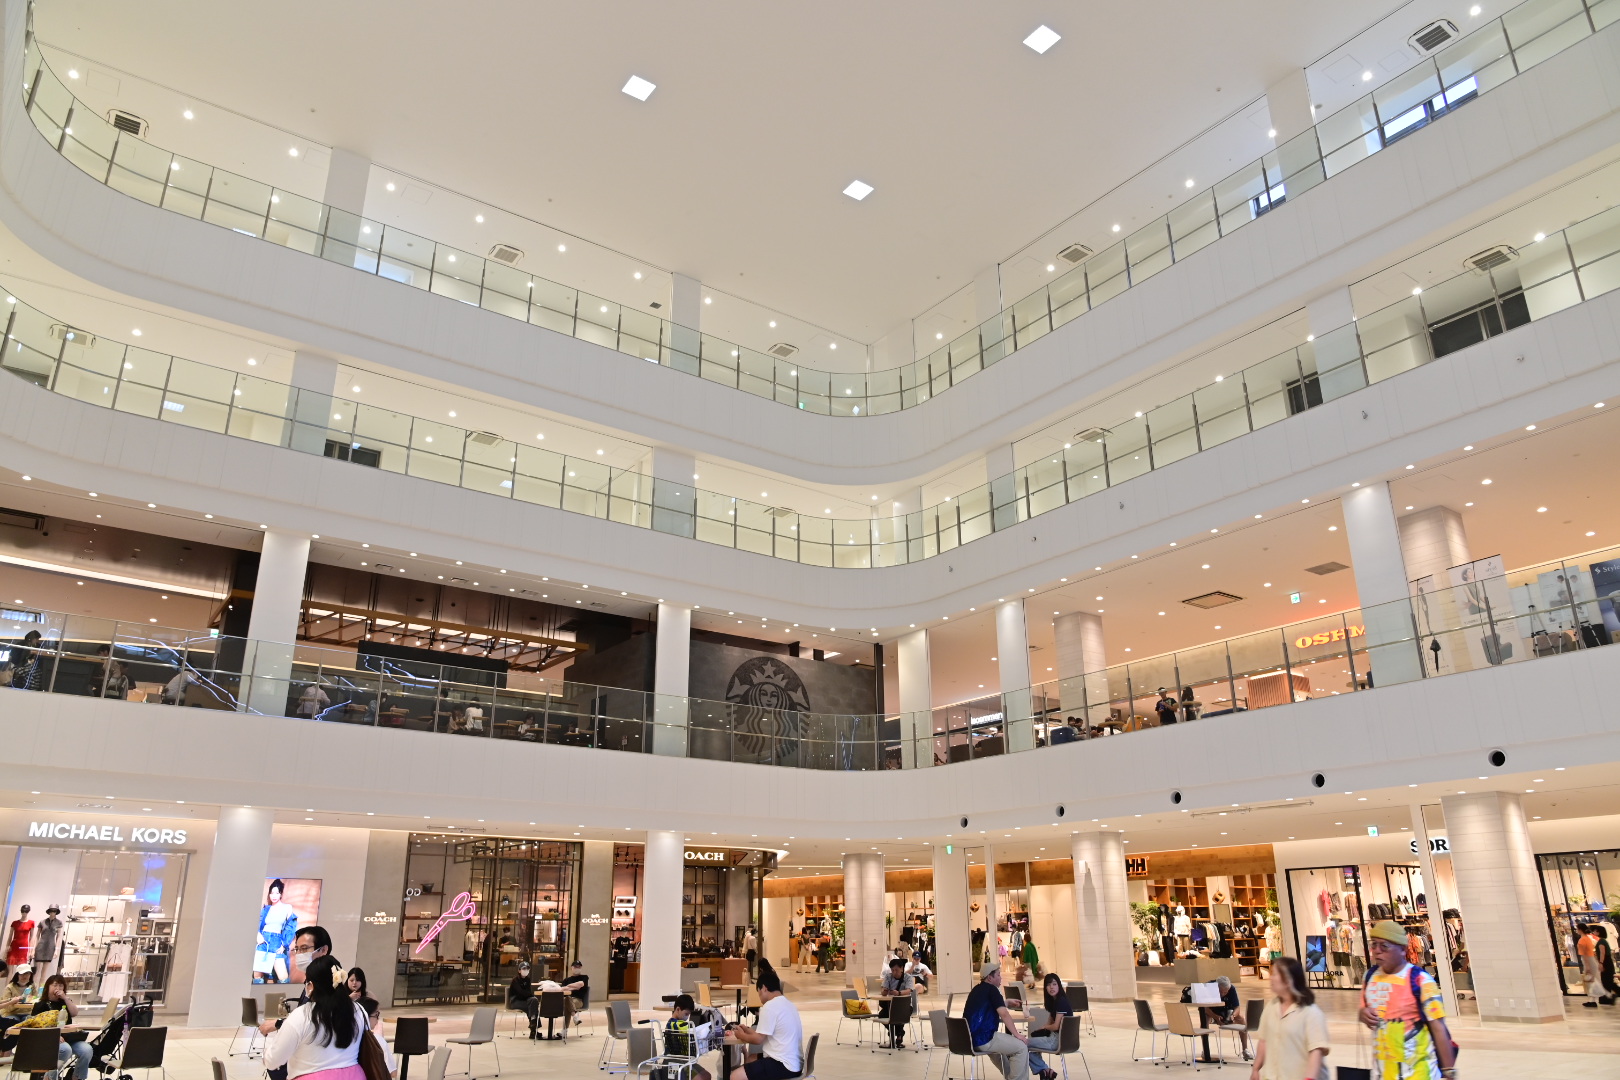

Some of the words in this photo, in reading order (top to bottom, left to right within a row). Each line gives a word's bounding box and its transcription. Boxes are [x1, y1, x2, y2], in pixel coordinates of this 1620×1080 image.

[28, 821, 124, 842] MICHAEL
[130, 827, 188, 845] KORS
[684, 851, 725, 861] OACH
[1125, 857, 1147, 873] HH
